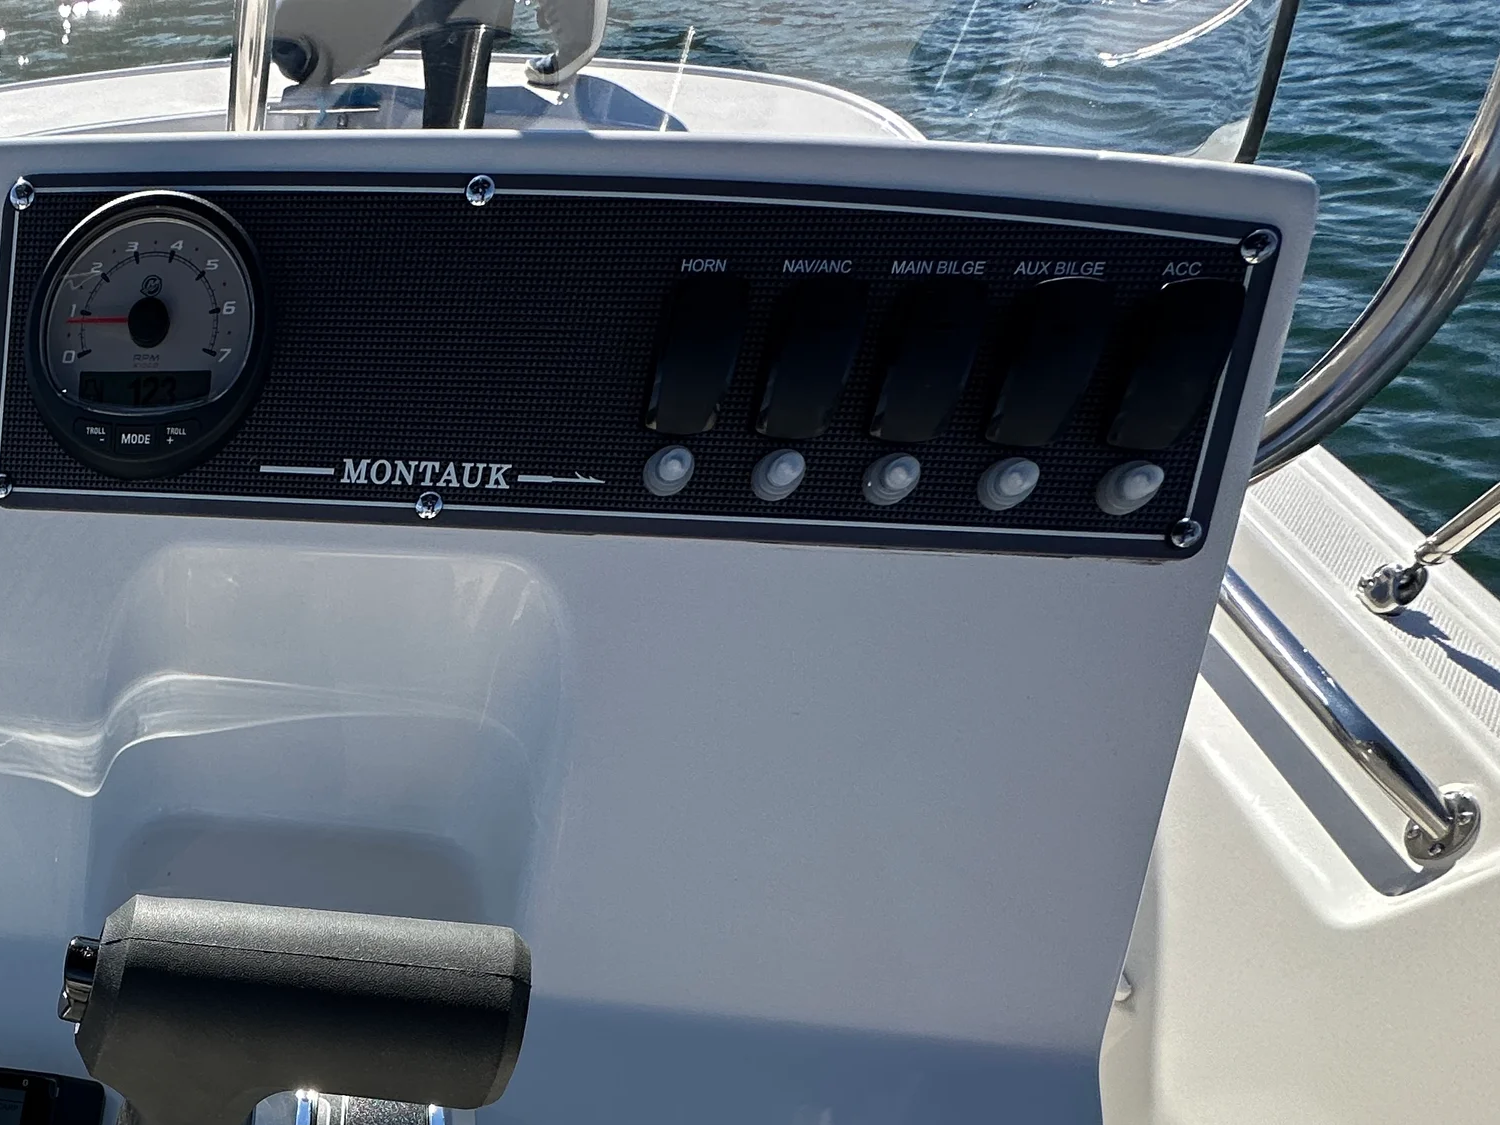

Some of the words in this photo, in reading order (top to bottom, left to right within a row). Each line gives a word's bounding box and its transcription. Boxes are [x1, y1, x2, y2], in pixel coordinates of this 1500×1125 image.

[125, 241, 139, 252] 3
[170, 240, 184, 251] 4
[90, 262, 103, 273] 2
[205, 259, 219, 271] 5
[680, 258, 727, 273] HORN
[782, 259, 853, 275] NAV/ANC
[890, 260, 936, 276] MAIN
[937, 260, 987, 276] BILGE
[1013, 261, 1053, 277] AUX
[1054, 261, 1106, 277] BILGE
[1162, 262, 1202, 277] ACC
[70, 303, 77, 317] 1
[222, 301, 236, 315] 6
[62, 350, 76, 364] 0
[133, 354, 160, 362] RPM
[217, 349, 231, 362] 7
[86, 427, 106, 435] TROLL
[166, 427, 186, 436] TROLL
[121, 434, 151, 445] MODE
[340, 458, 512, 490] MONTAUK
